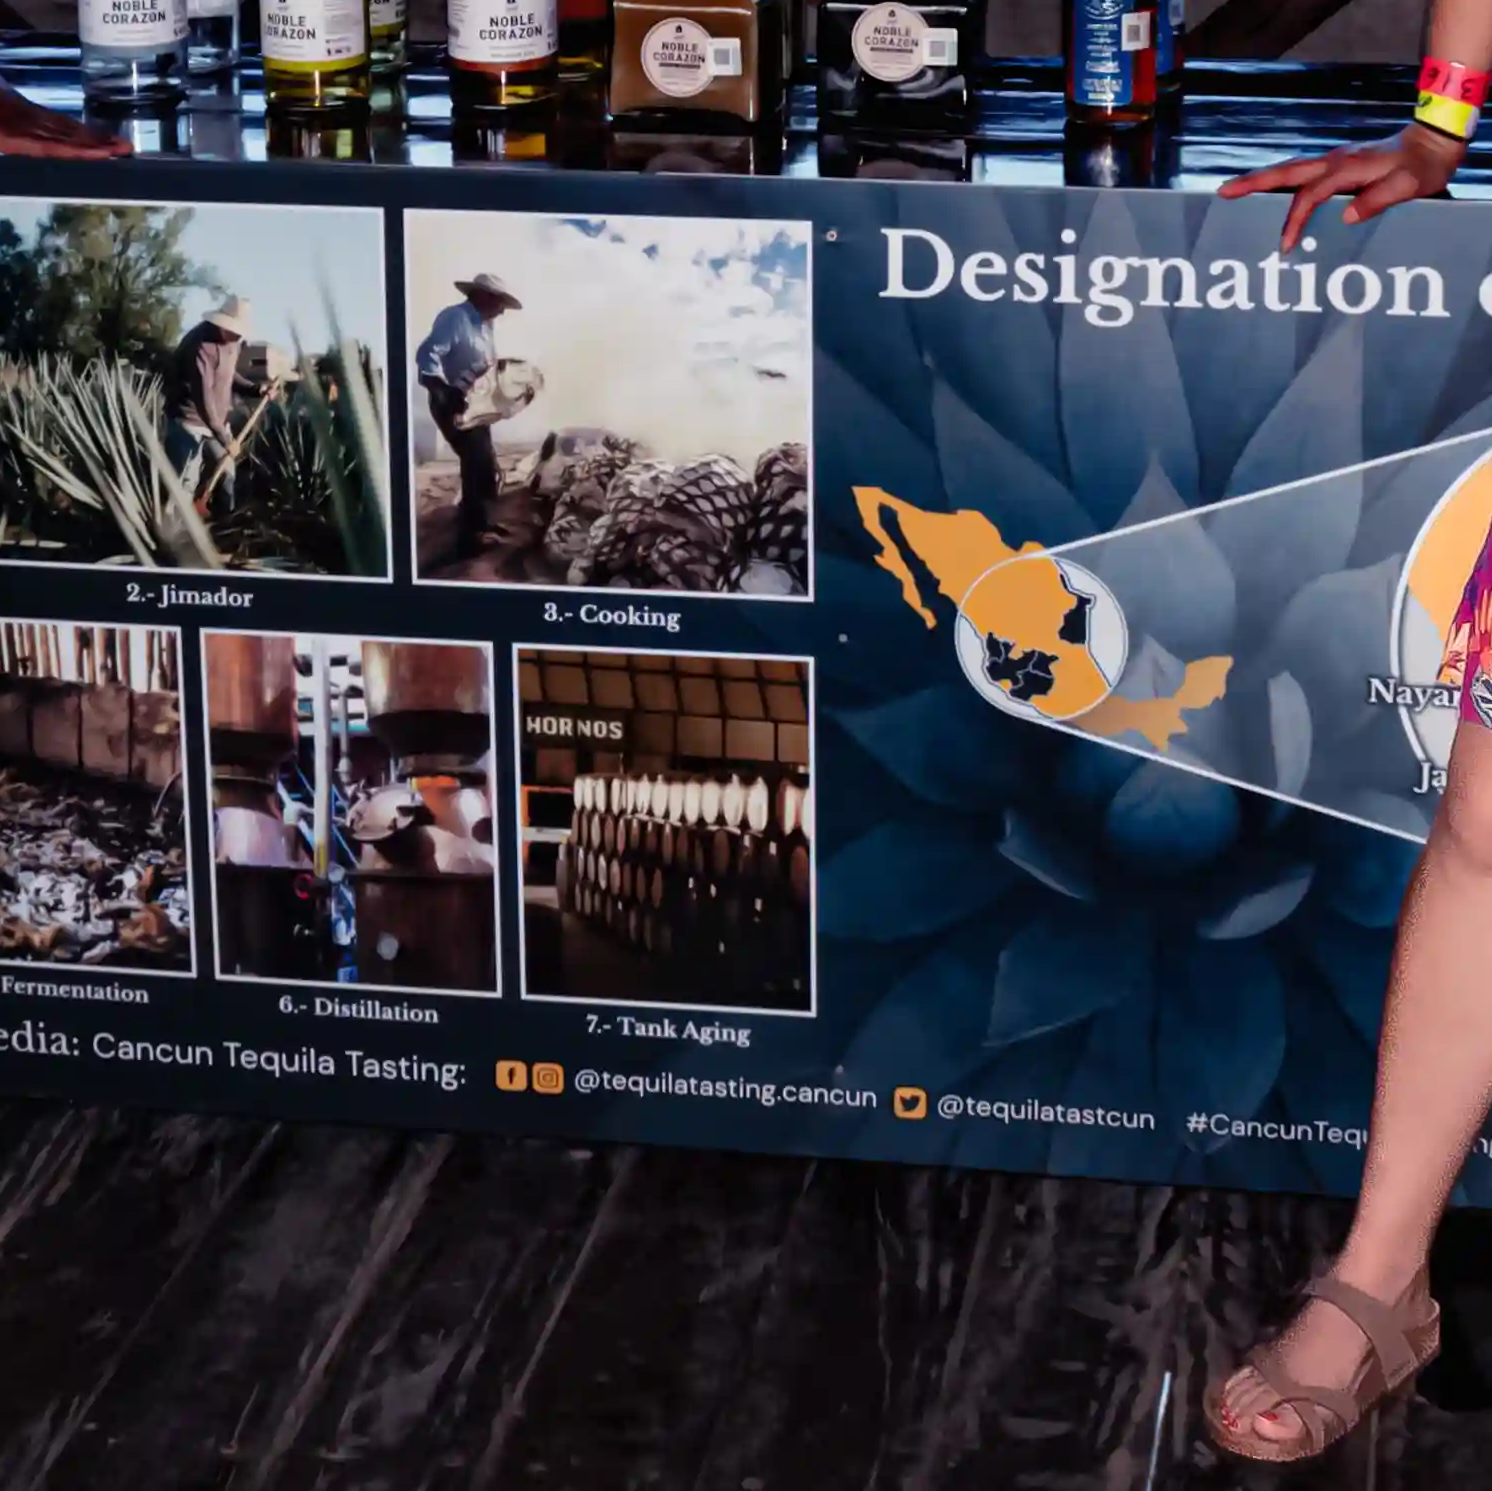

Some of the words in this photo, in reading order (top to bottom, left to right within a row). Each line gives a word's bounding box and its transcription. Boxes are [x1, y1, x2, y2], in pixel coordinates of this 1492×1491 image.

[102, 10, 166, 24] CORAZON
[267, 13, 306, 27] NOBLE
[489, 12, 534, 28] NOBLE
[479, 25, 543, 40] CORAZON
[653, 51, 706, 64] CORAZON
[661, 42, 699, 53] NOBLE
[879, 228, 1451, 327] Designation
[157, 583, 255, 609] Jimador
[579, 603, 682, 633] Cooking
[525, 715, 624, 741] HORNOS
[1, 975, 150, 1004] Fermentation
[314, 997, 439, 1024] Distillation
[616, 1015, 678, 1039] Tank
[681, 1020, 752, 1049] Aging
[92, 1032, 213, 1066] Cancun
[222, 1041, 335, 1078] Tequila
[344, 1050, 466, 1091] Tasting:
[574, 1068, 878, 1109] @tequilatasting.cancun
[937, 1094, 1155, 1130] @tequilatastcun
